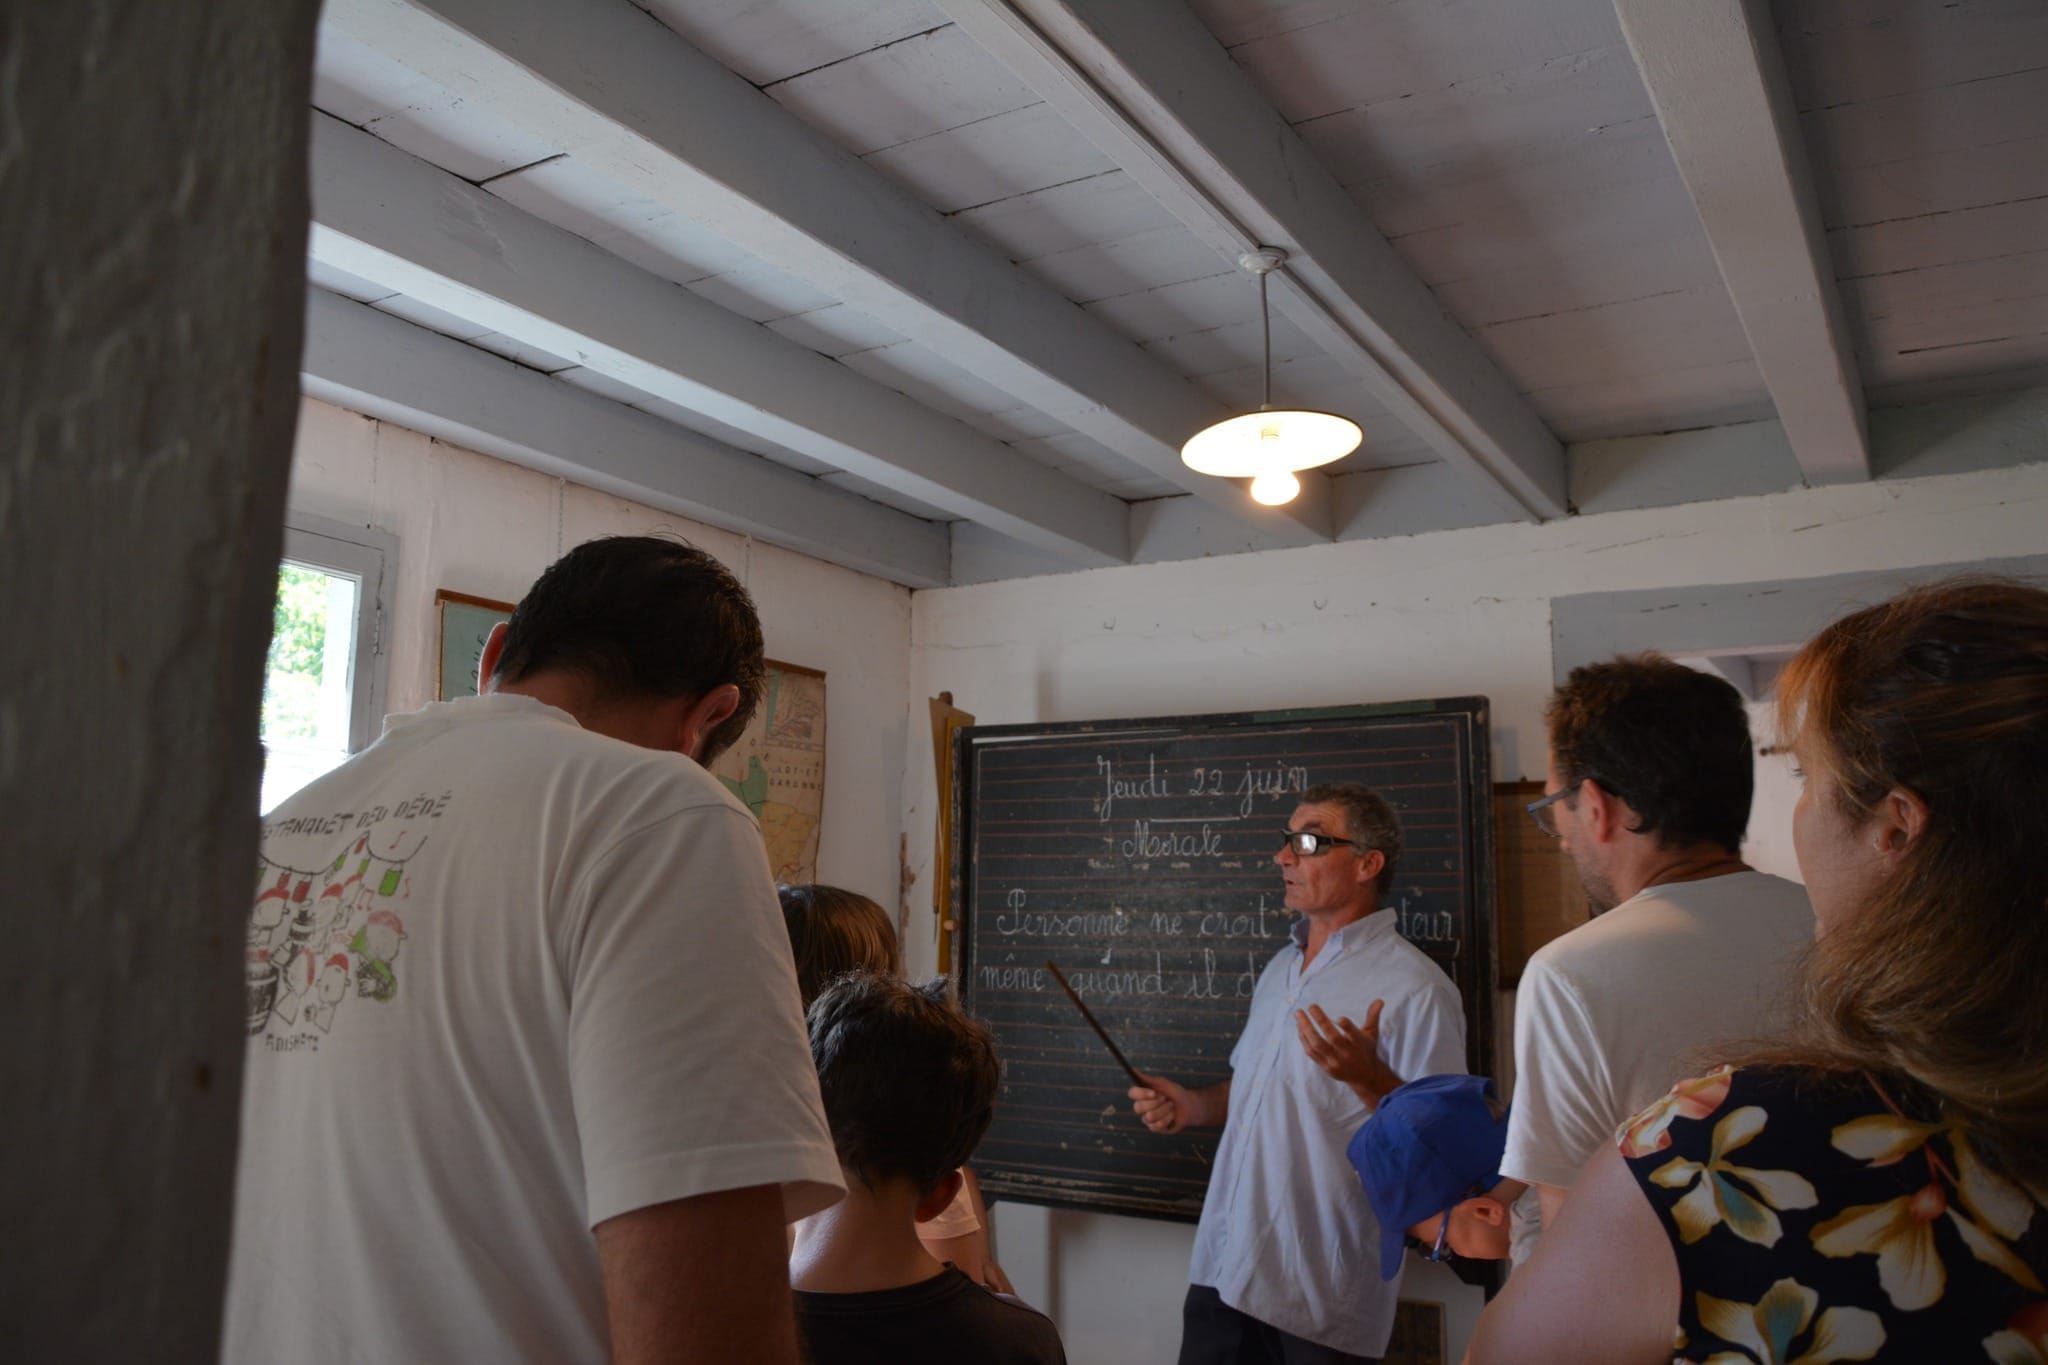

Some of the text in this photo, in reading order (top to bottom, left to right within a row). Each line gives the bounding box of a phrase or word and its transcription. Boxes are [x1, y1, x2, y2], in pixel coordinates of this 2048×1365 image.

[1096, 752, 1309, 823] Jeudi 22 juin
[1122, 819, 1225, 858] Morale
[996, 888, 1461, 958] Personne ne croit teur,
[979, 952, 1046, 992] même
[1067, 950, 1169, 1001] quand
[1184, 947, 1222, 999] il
